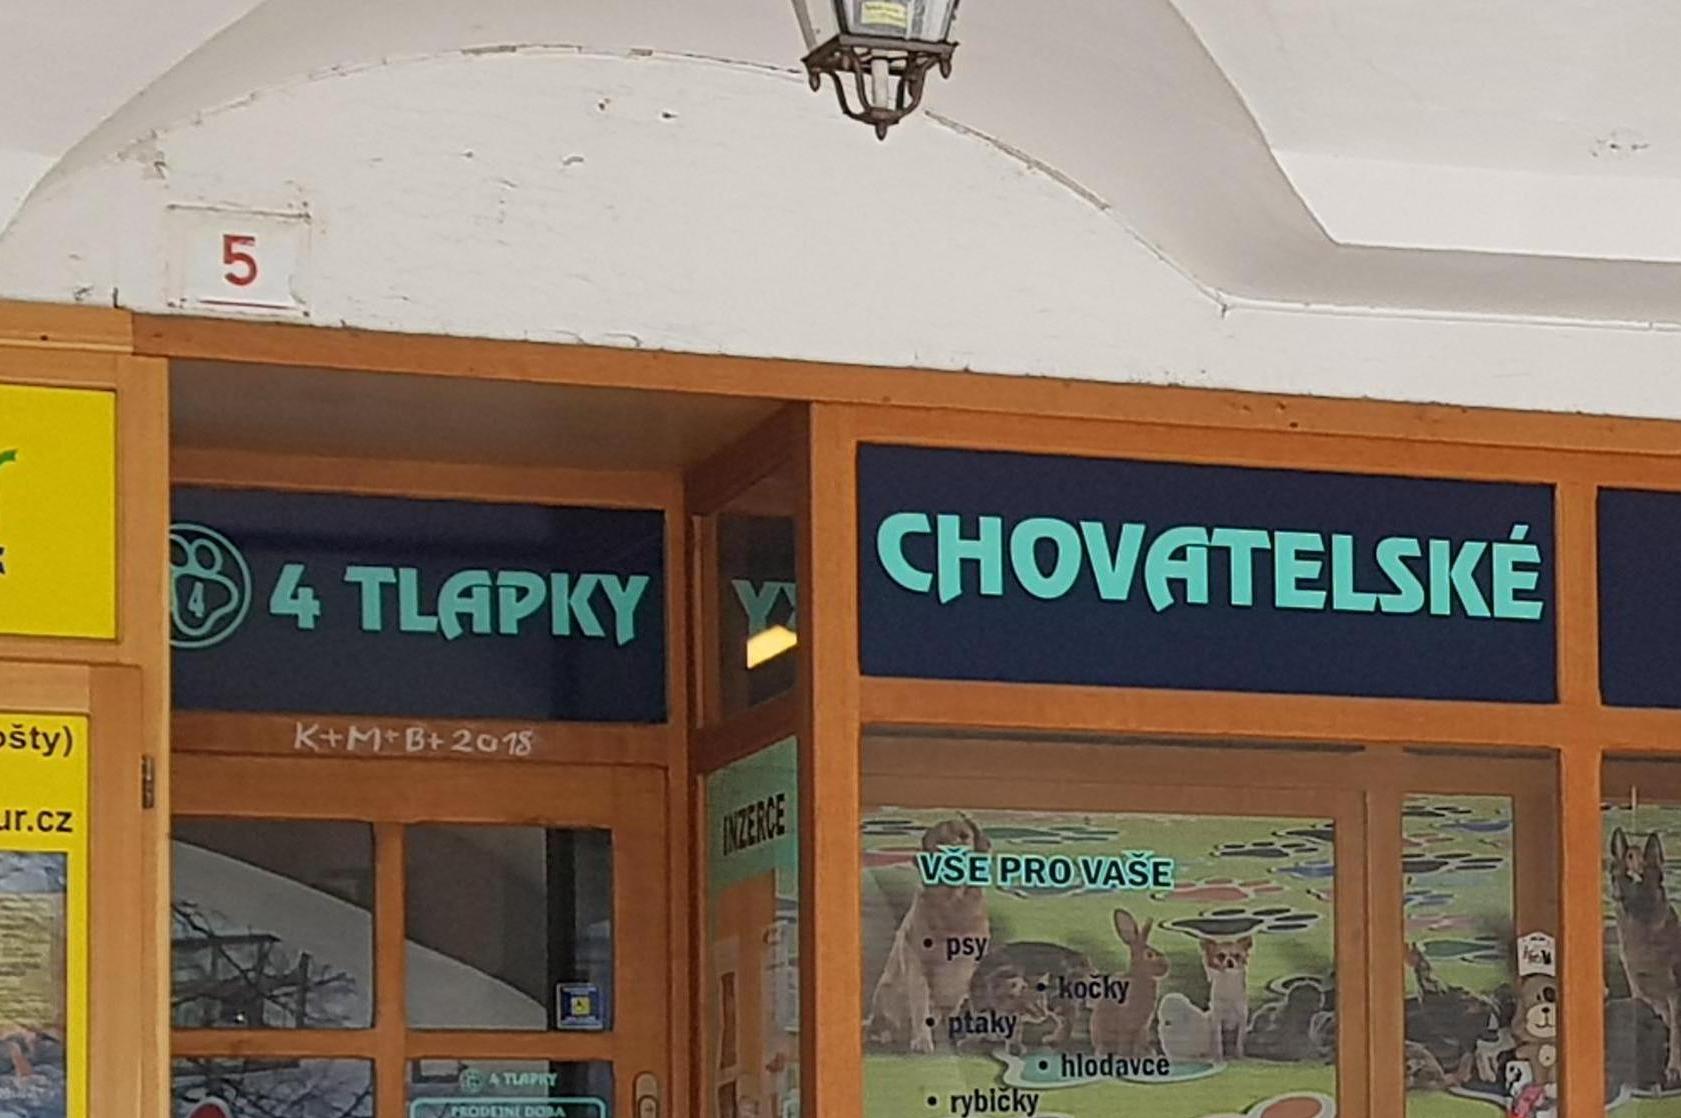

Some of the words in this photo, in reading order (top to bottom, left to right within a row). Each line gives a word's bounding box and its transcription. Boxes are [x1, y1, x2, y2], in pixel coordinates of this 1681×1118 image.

[223, 233, 257, 286] 5
[877, 513, 1544, 620] CHOVATELSKÉ
[269, 563, 321, 630] 4
[344, 566, 650, 646] TLAPKY
[722, 793, 785, 856] INZERCE
[918, 844, 991, 885] VŠE
[999, 853, 1073, 884] PRO
[1079, 850, 1175, 889] VAŠE
[946, 936, 987, 960] psy
[1058, 974, 1130, 1004] kočky
[1061, 1054, 1170, 1078] hlodavce
[950, 1088, 1039, 1118] rybičky
